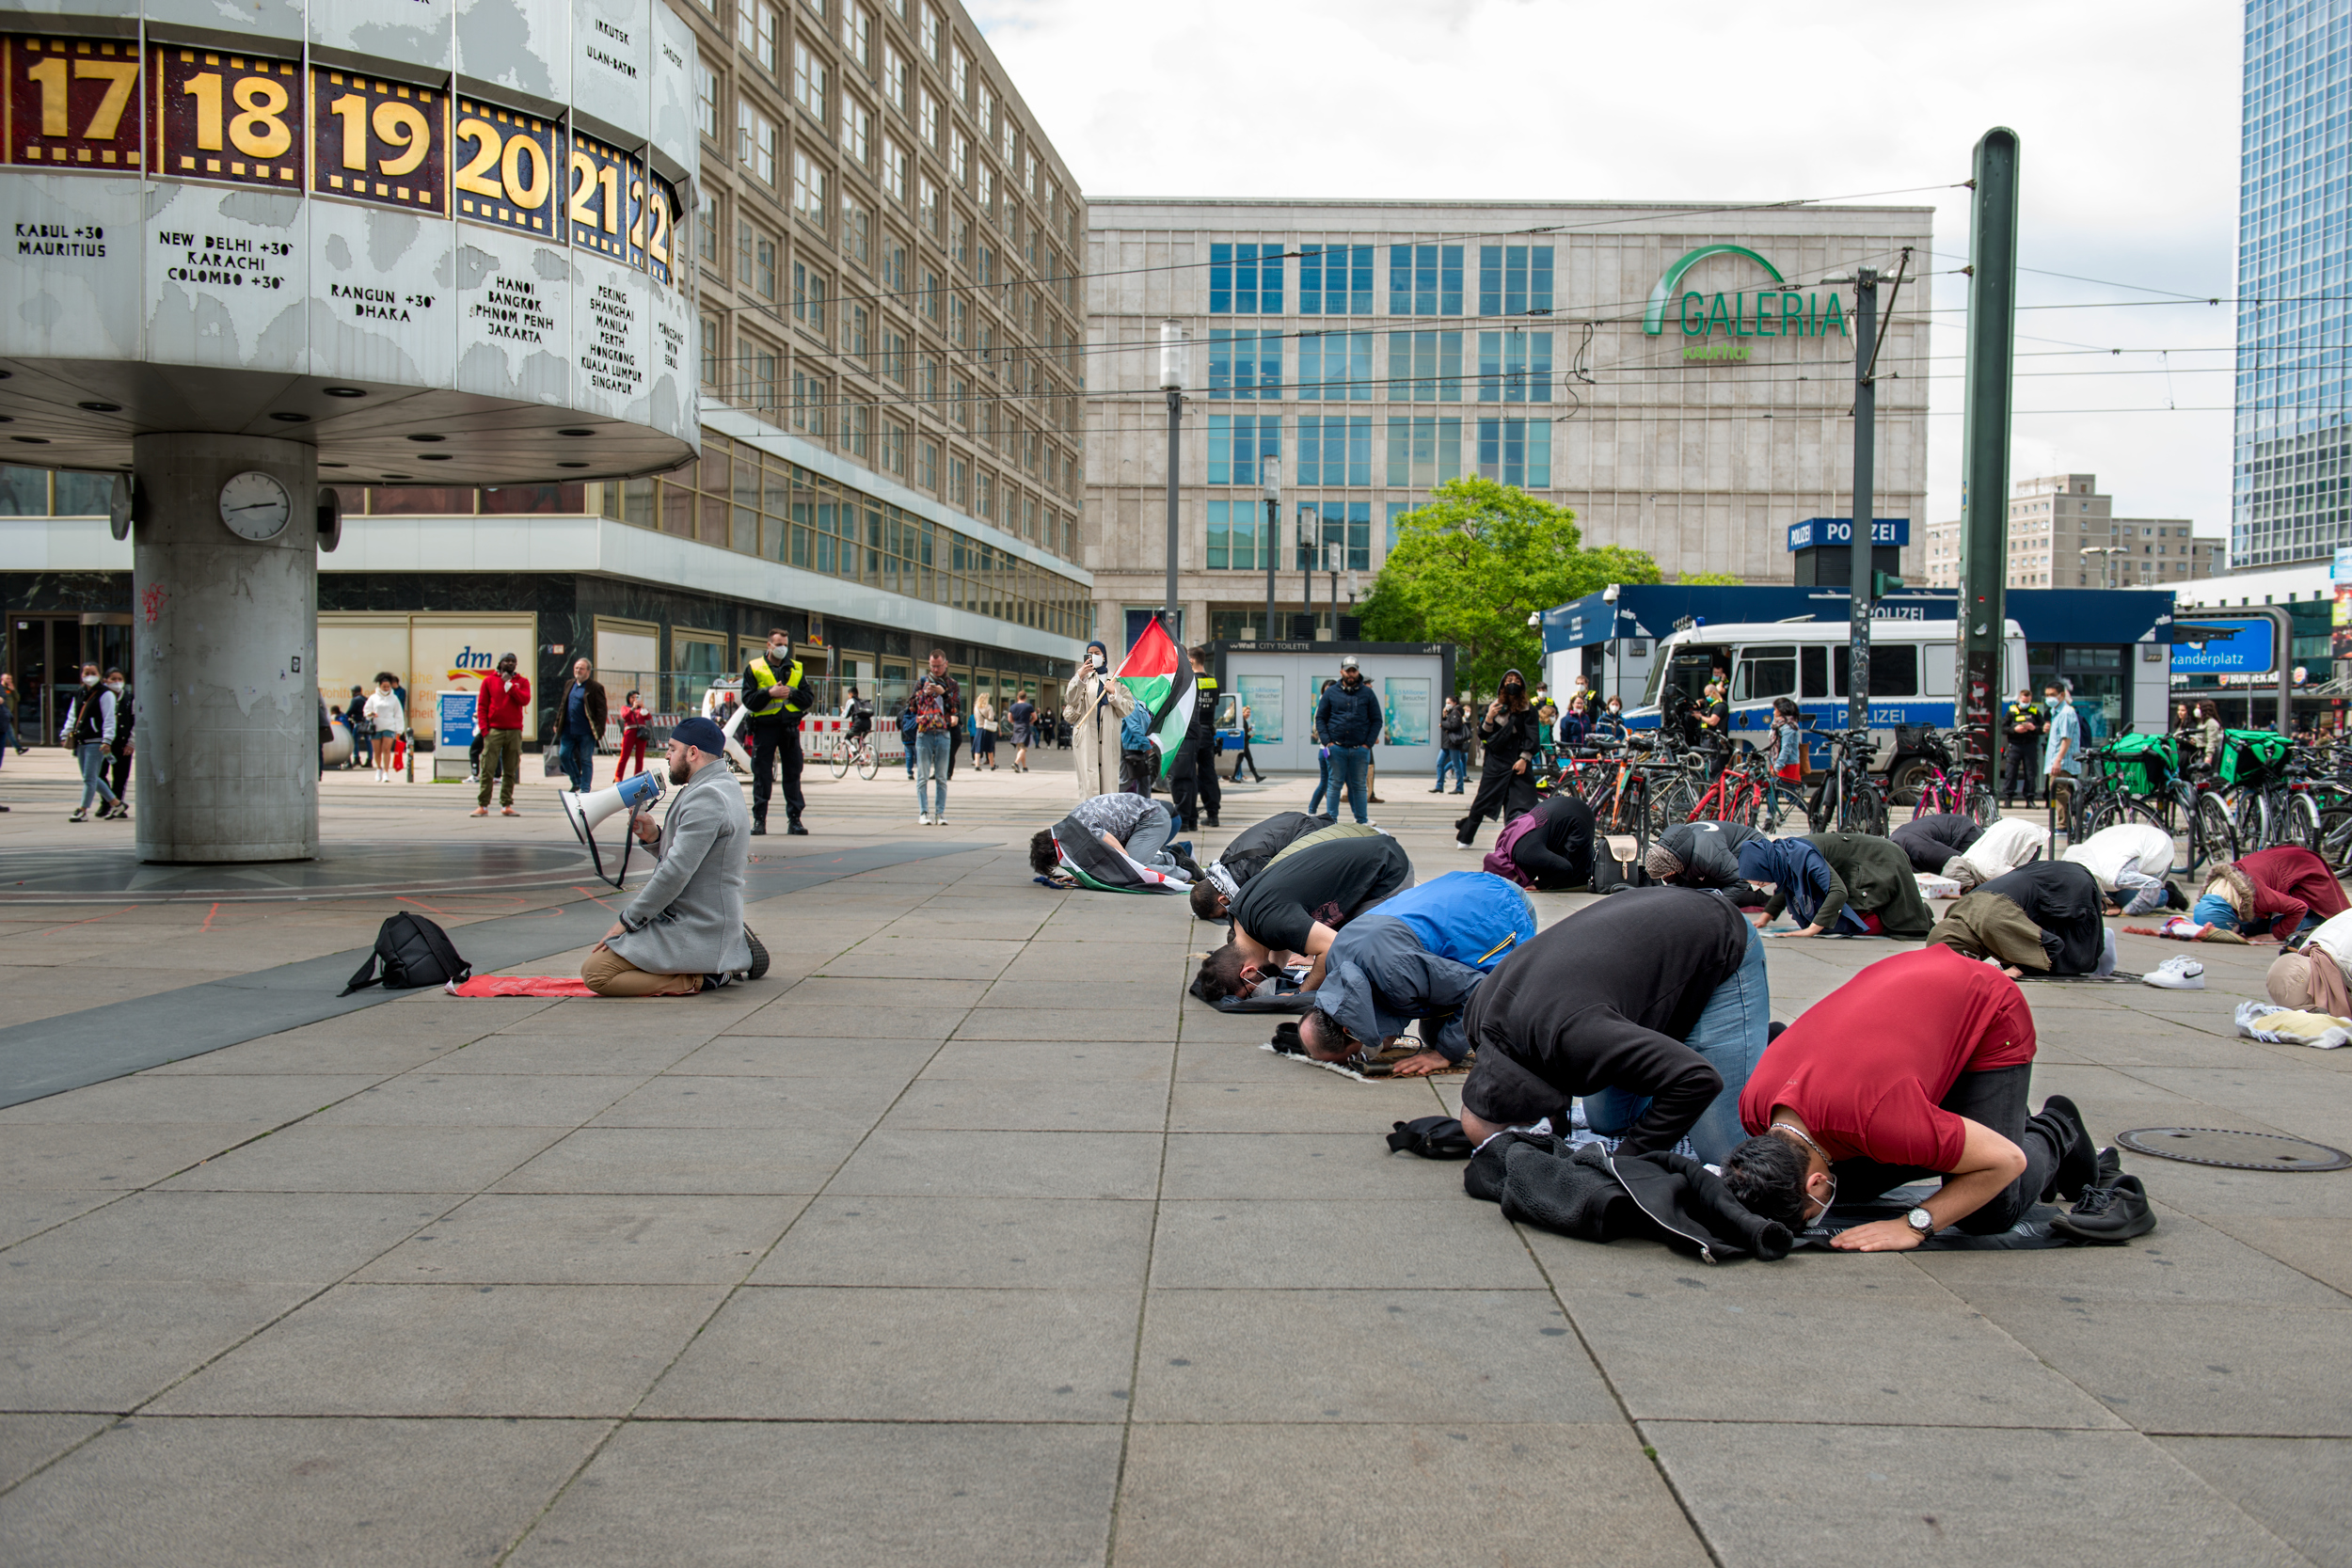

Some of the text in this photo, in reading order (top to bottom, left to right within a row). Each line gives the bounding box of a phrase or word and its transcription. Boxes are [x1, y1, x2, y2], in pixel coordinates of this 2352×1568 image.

[595, 19, 629, 46] IRKUTSK
[587, 44, 638, 80] ULAN-BATOR
[27, 57, 140, 140] 17
[183, 73, 293, 160] 18
[331, 94, 431, 176] 19
[456, 119, 550, 211] 20
[571, 150, 618, 235] 21
[15, 223, 69, 238] KABUL
[629, 180, 668, 265] 22
[18, 241, 106, 257] MAURITIUS
[159, 231, 195, 246] NEW
[205, 236, 252, 252] DELHI
[187, 251, 265, 271] KARACHI
[167, 267, 242, 286] COLOMBO
[497, 277, 534, 294] HANOI
[331, 284, 395, 304] RANGUN
[488, 291, 542, 312] BANGKOK
[598, 285, 627, 305] PEKING
[356, 304, 411, 323] DHAKA
[476, 305, 553, 330] PHNOM PENH
[590, 298, 634, 322] SHANGHAI
[1680, 291, 1848, 338] GALERIA
[488, 323, 542, 344] JAKARTA
[596, 315, 628, 335] MANILA
[600, 331, 625, 349] PERTH
[665, 340, 678, 356] TOKYO
[590, 343, 635, 366] HONGKONG
[665, 354, 678, 370] SEOUL
[580, 356, 643, 384] KUALA LUMPUR
[592, 374, 632, 395] SINGAPUR
[1790, 525, 1811, 546] POLIZEI
[1827, 523, 1896, 541] POZEI
[455, 645, 492, 669] dm
